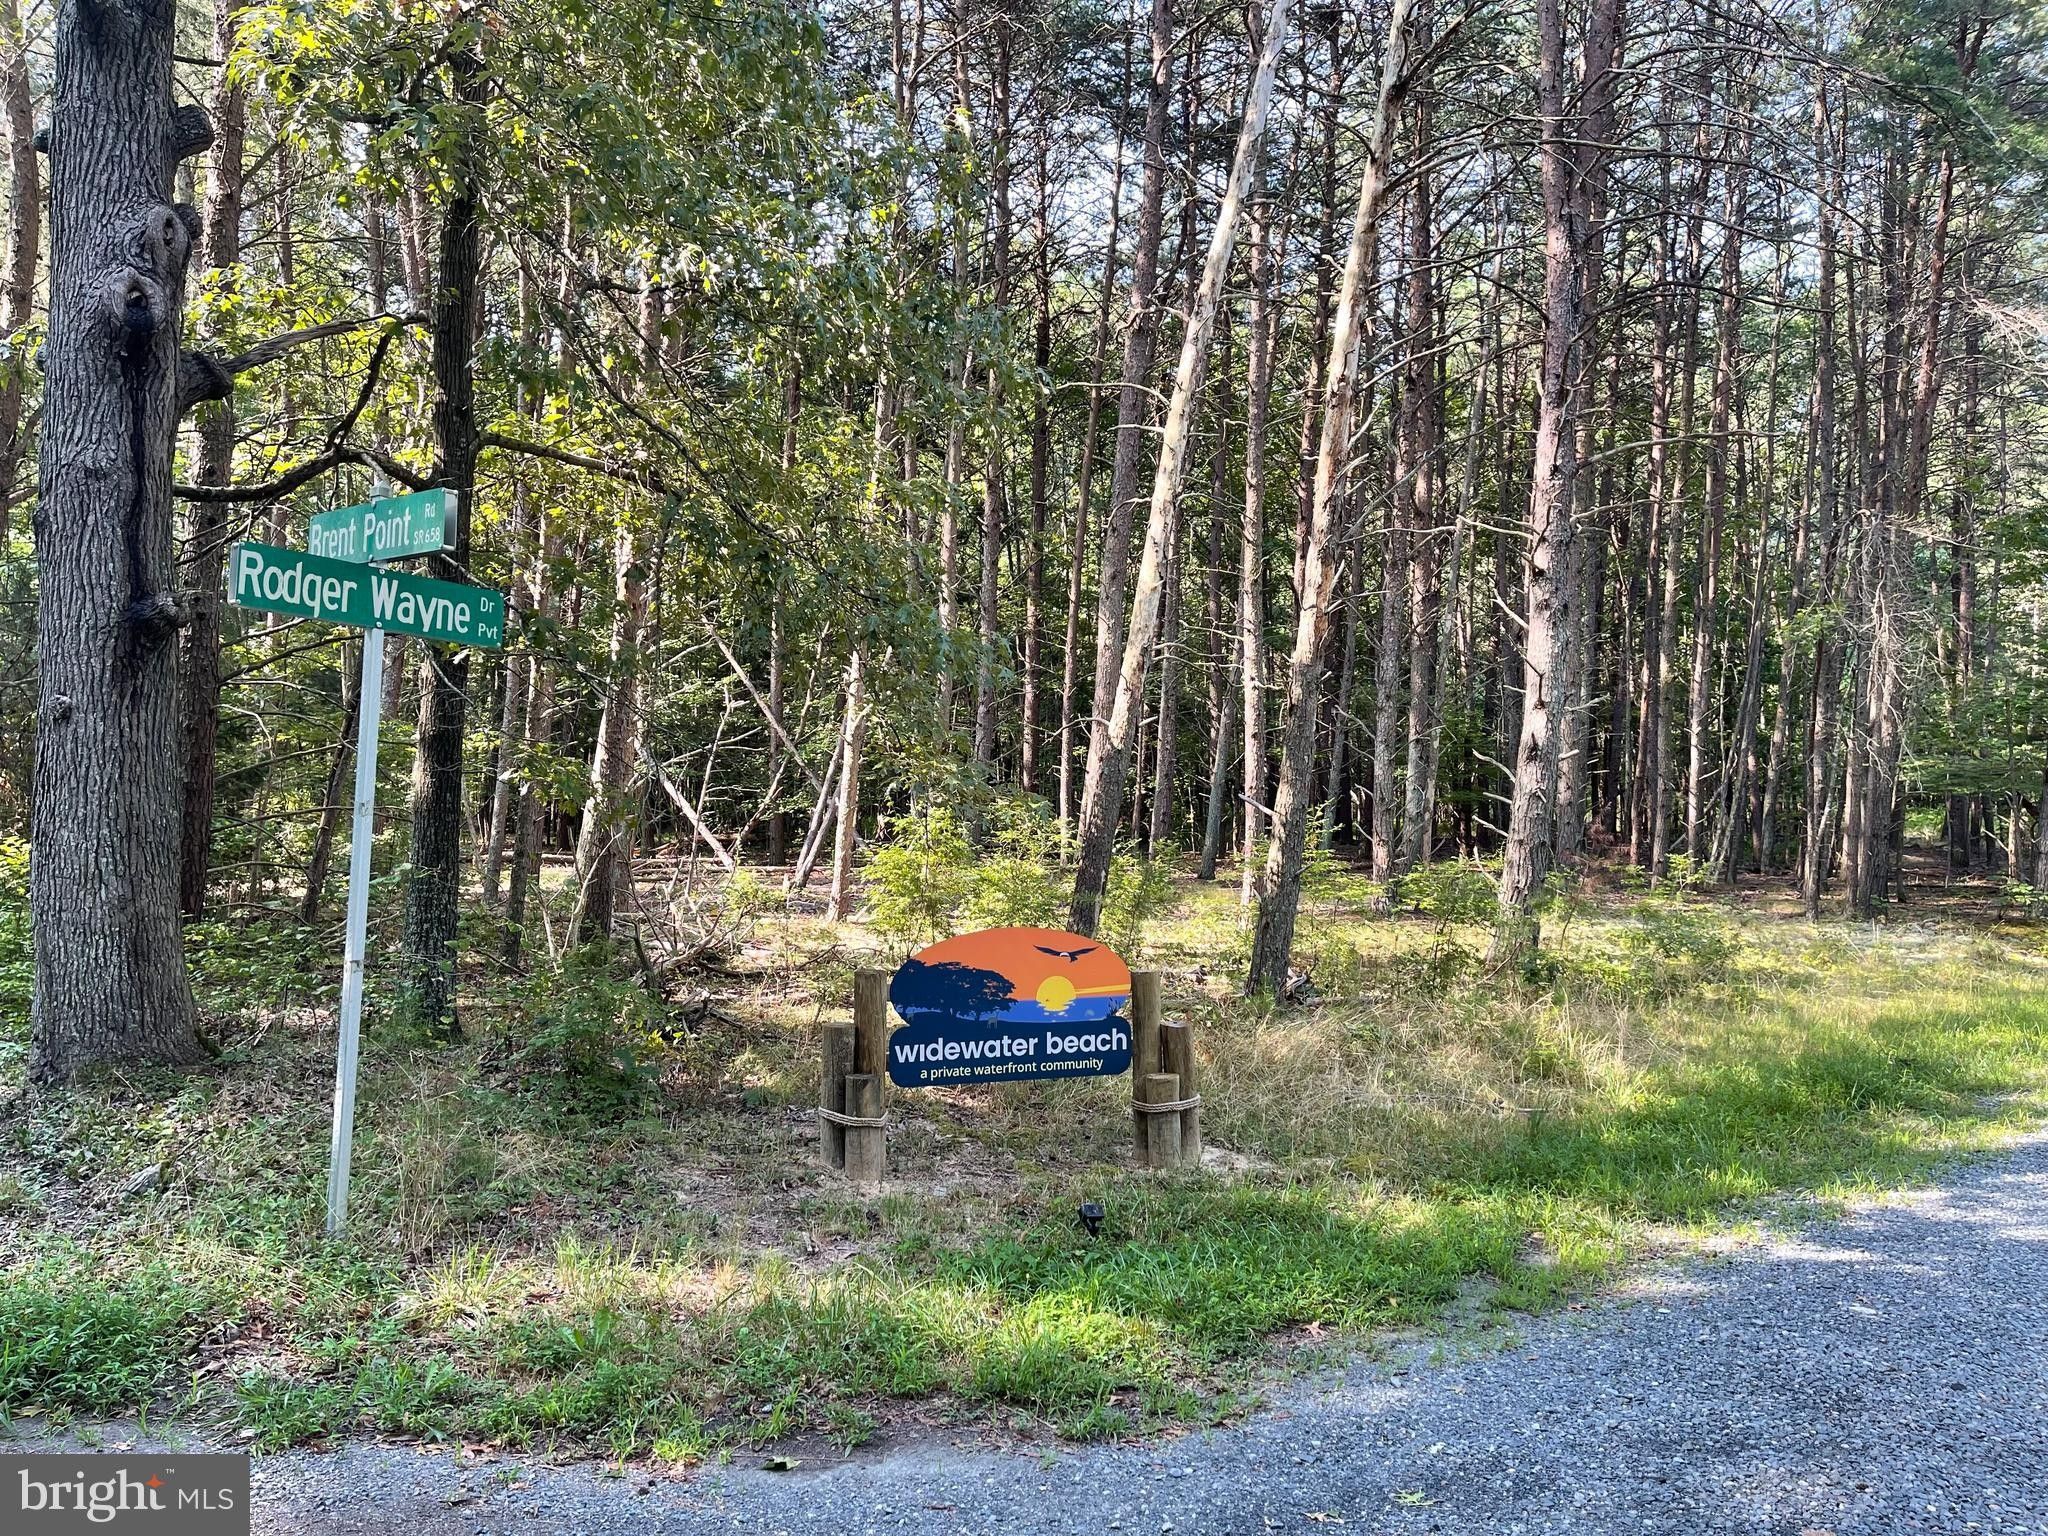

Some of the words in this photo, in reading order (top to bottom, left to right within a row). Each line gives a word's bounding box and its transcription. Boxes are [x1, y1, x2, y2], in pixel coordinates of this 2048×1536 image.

[424, 502, 436, 518] Rd
[310, 519, 357, 558] Brent
[363, 506, 412, 551] Point
[237, 549, 358, 618] Rodger
[371, 575, 471, 633] Wayne
[480, 596, 495, 614] Dr
[478, 623, 498, 640] Pvt
[894, 1035, 1038, 1063] widewater
[1046, 1028, 1127, 1054] beach
[920, 1069, 928, 1079] a
[930, 1065, 972, 1081] private
[974, 1061, 1037, 1076] waterfront
[1040, 1057, 1104, 1072] community
